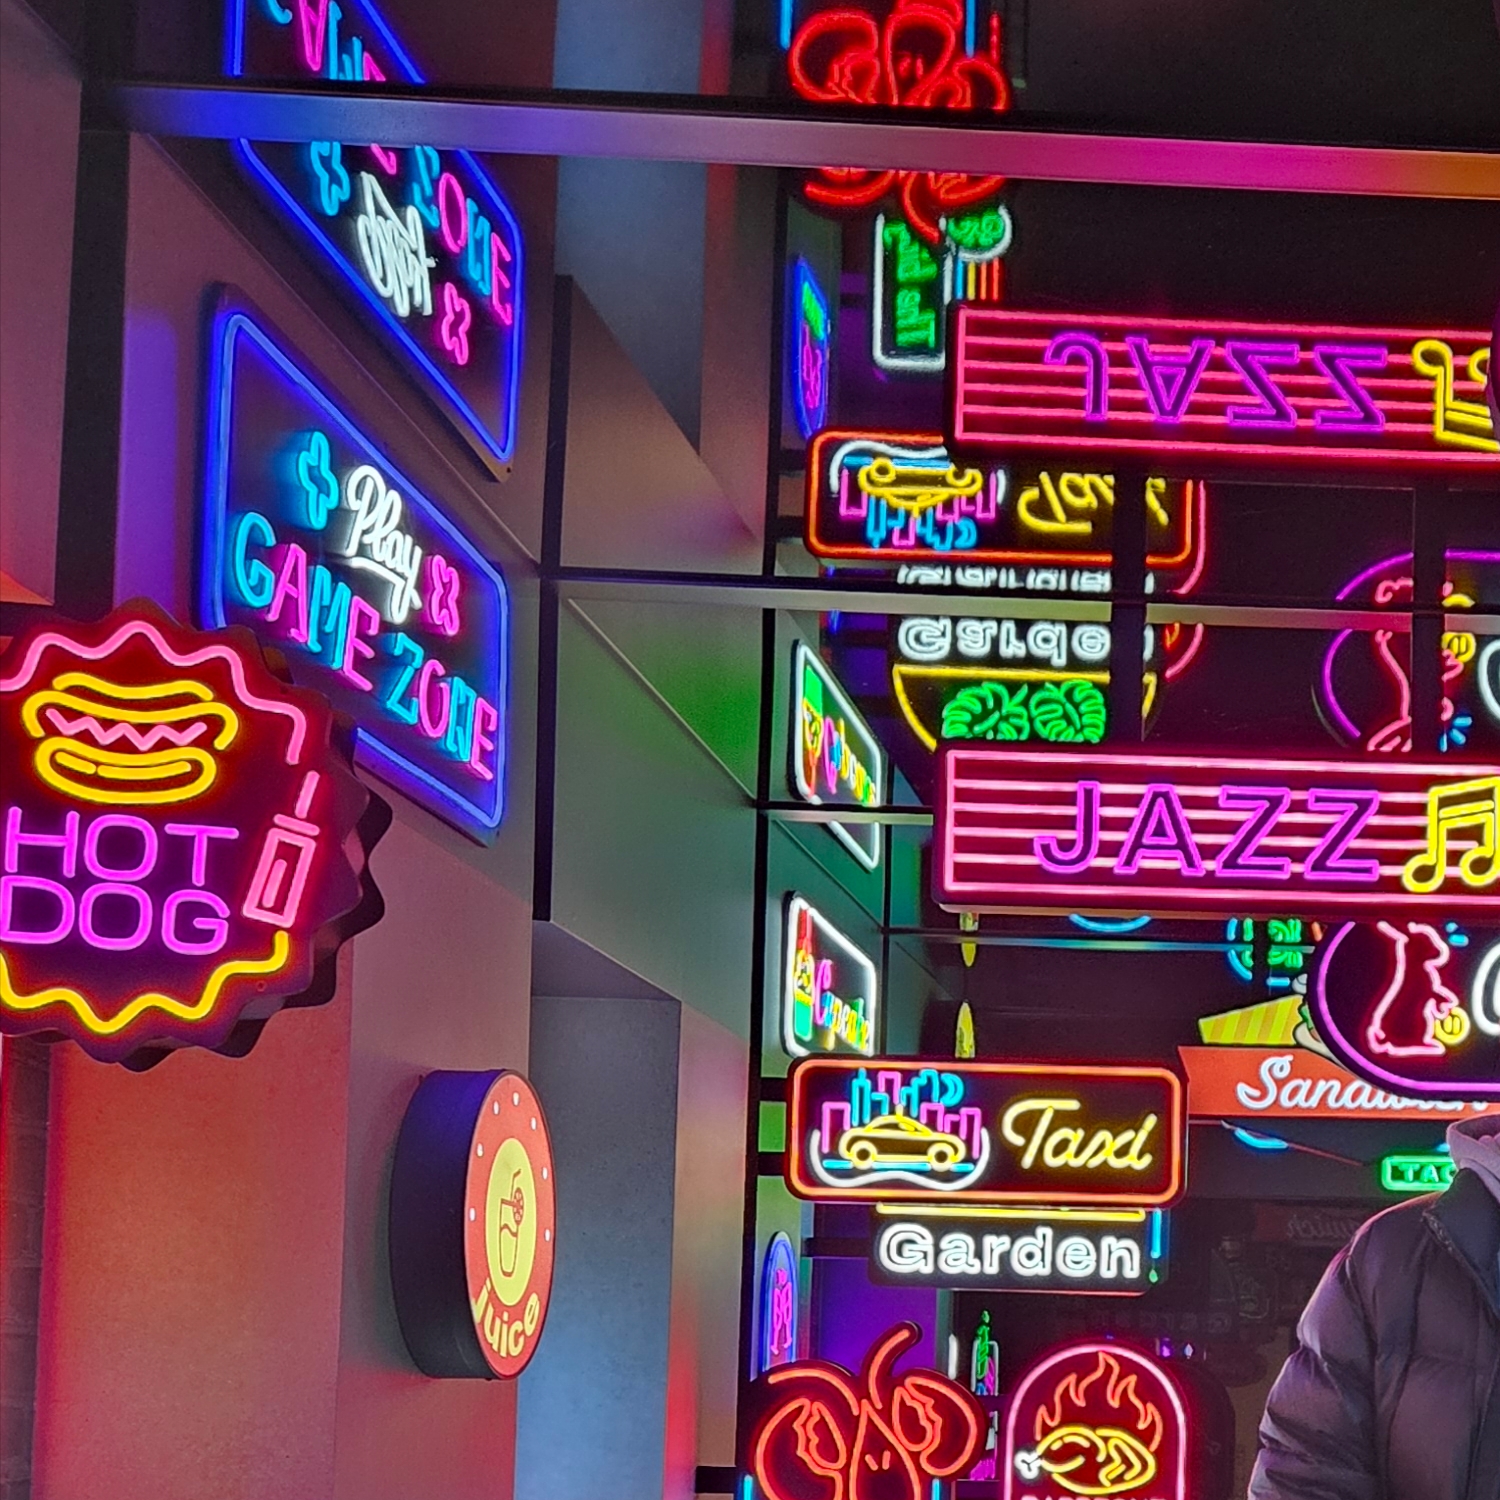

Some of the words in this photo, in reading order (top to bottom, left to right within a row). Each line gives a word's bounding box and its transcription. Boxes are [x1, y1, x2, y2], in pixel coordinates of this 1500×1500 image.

[345, 464, 423, 625] Play
[235, 511, 381, 692] GAME
[386, 631, 498, 781] ZONE
[4, 805, 240, 885] HOT
[1033, 780, 1381, 881] JAZZ
[0, 876, 230, 955] DOG
[1002, 1098, 1157, 1171] Taxi
[1398, 1162, 1458, 1184] TAC
[878, 1221, 1141, 1279] Garden
